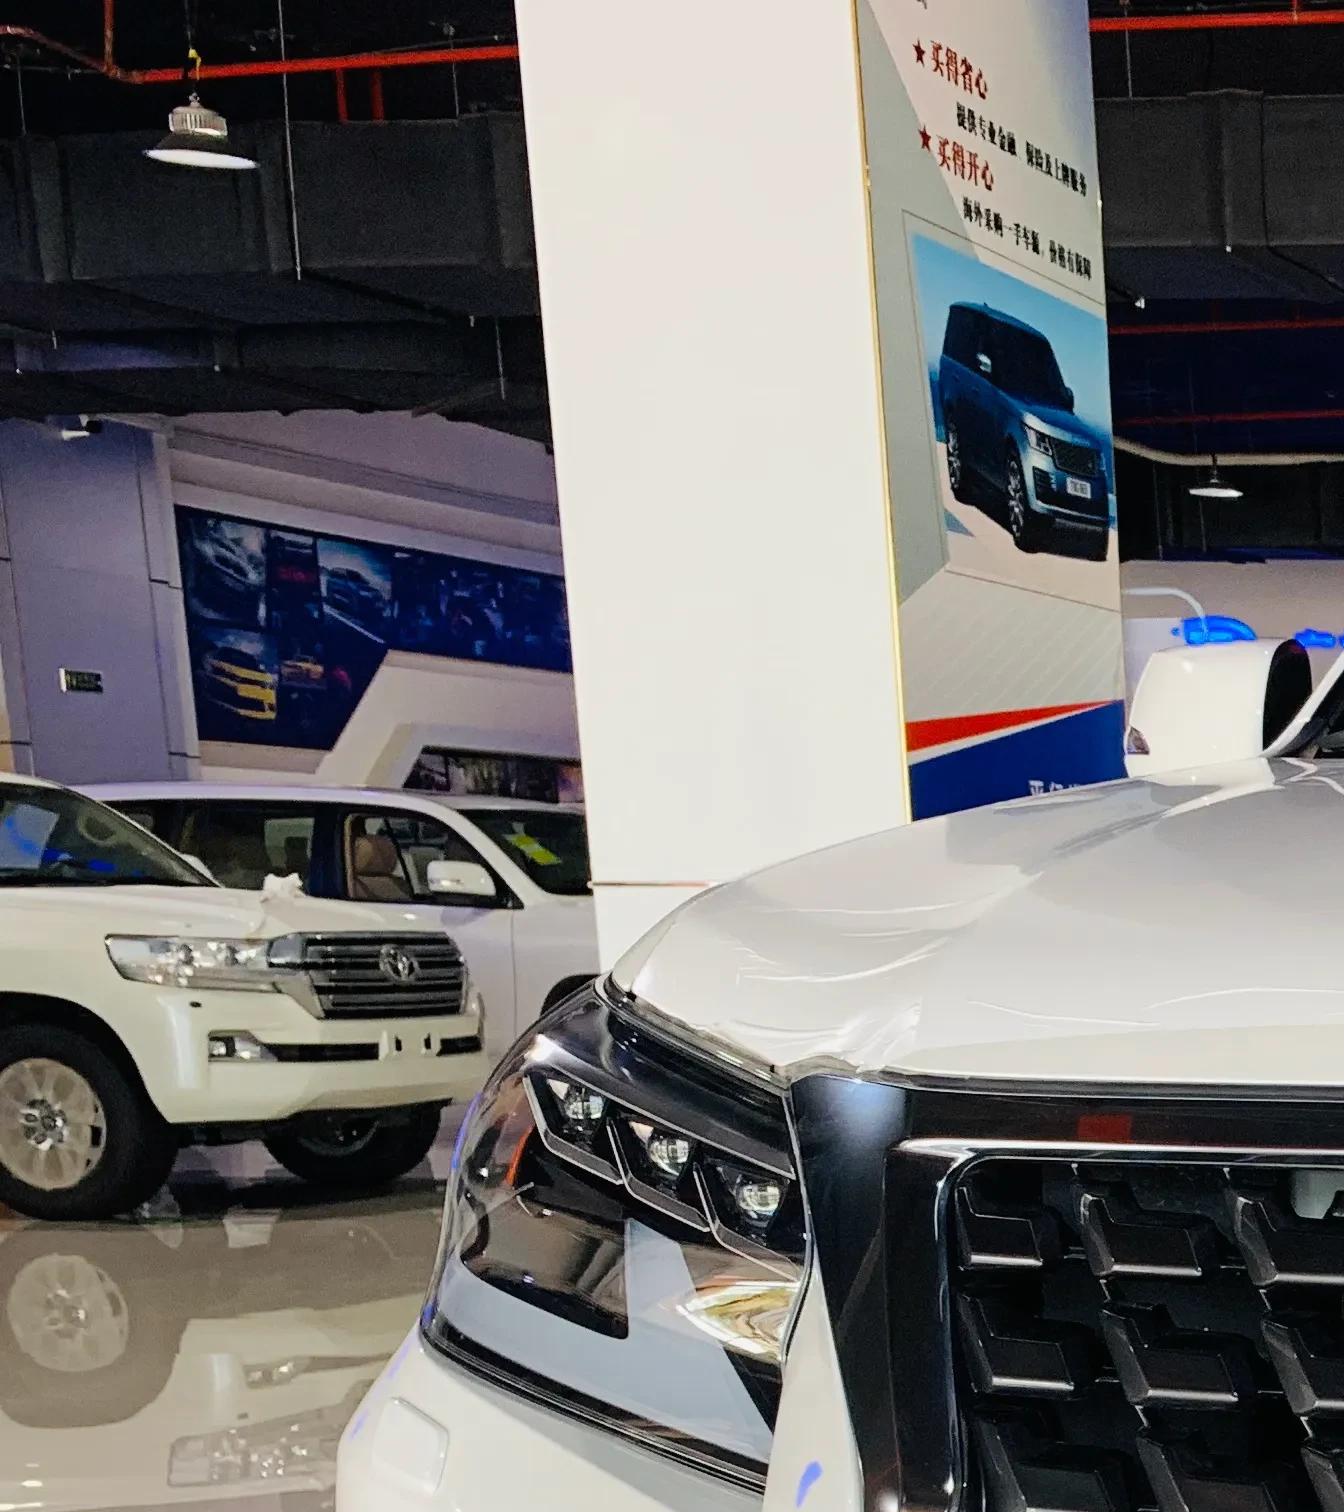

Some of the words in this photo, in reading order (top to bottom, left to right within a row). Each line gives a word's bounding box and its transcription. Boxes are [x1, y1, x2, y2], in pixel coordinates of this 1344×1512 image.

[931, 40, 988, 100] 买得省心
[936, 135, 994, 192] 买得开心
